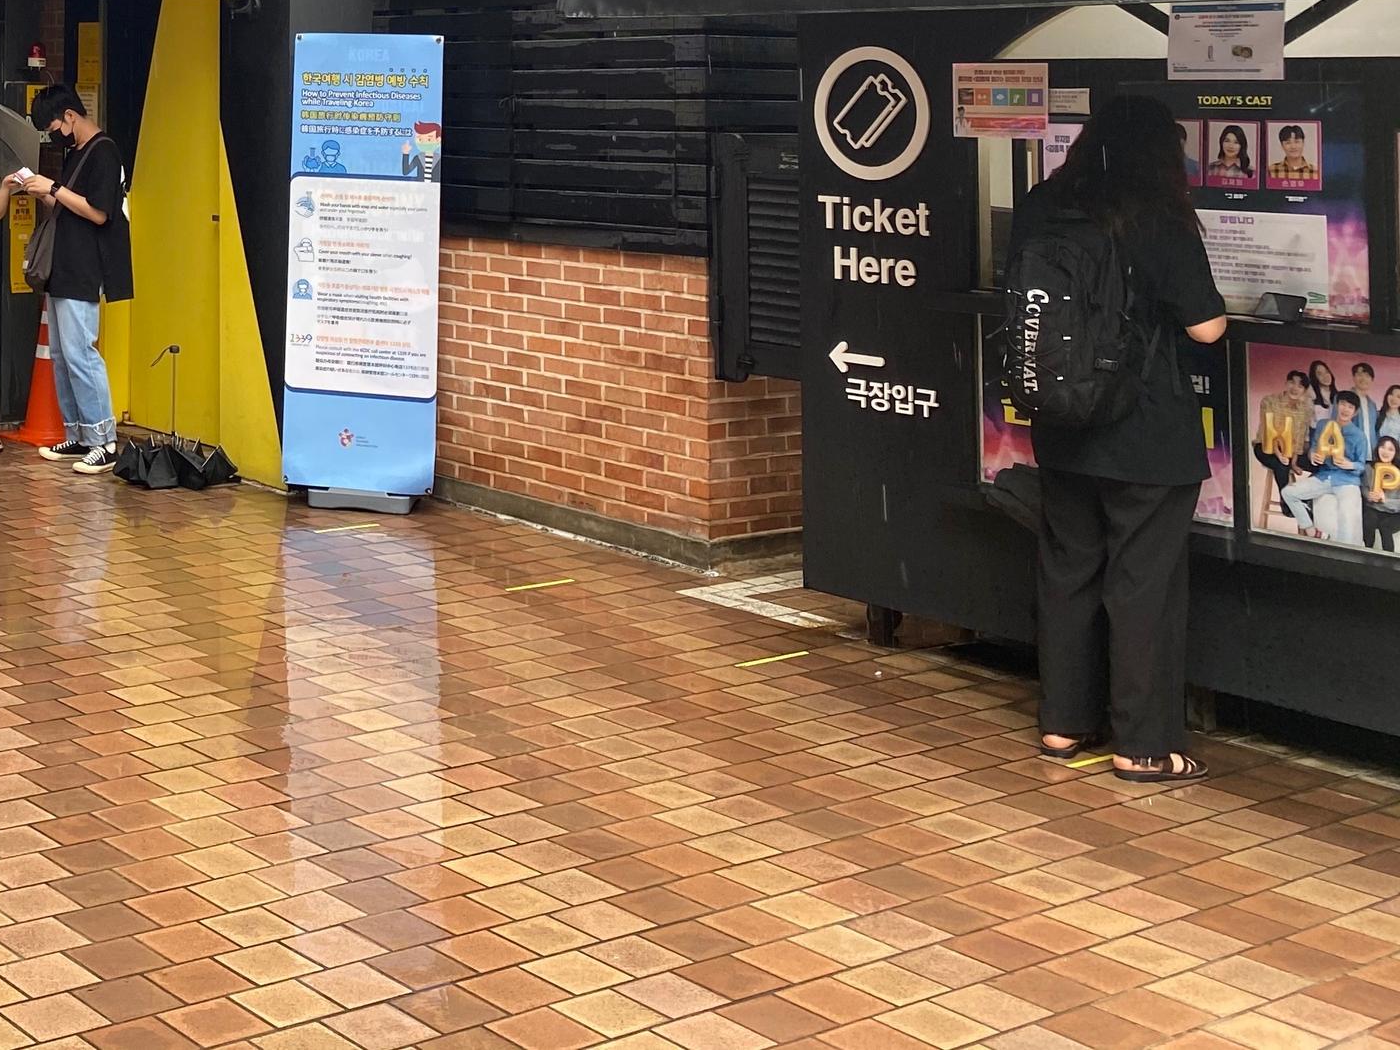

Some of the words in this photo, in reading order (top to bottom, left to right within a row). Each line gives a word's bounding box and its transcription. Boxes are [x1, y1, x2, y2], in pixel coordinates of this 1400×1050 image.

[302, 71, 341, 87] 한국여행
[343, 73, 353, 87] 시
[354, 72, 385, 87] 감염병
[386, 73, 408, 88] 예방
[408, 74, 430, 89] 수칙
[302, 90, 318, 98] How
[319, 90, 327, 98] to
[328, 90, 355, 98] Prevent
[356, 91, 390, 99] Infectious
[391, 92, 421, 100] Diseases
[321, 99, 353, 108] Traveling
[353, 99, 374, 107] Korea
[1197, 96, 1243, 105] TODAY'S
[1245, 96, 1273, 105] CAST
[817, 194, 931, 237] Ticket
[833, 246, 918, 287] Here
[290, 333, 313, 345] 1339
[1023, 289, 1050, 392] COVERNAT
[845, 377, 940, 418] 극장입구
